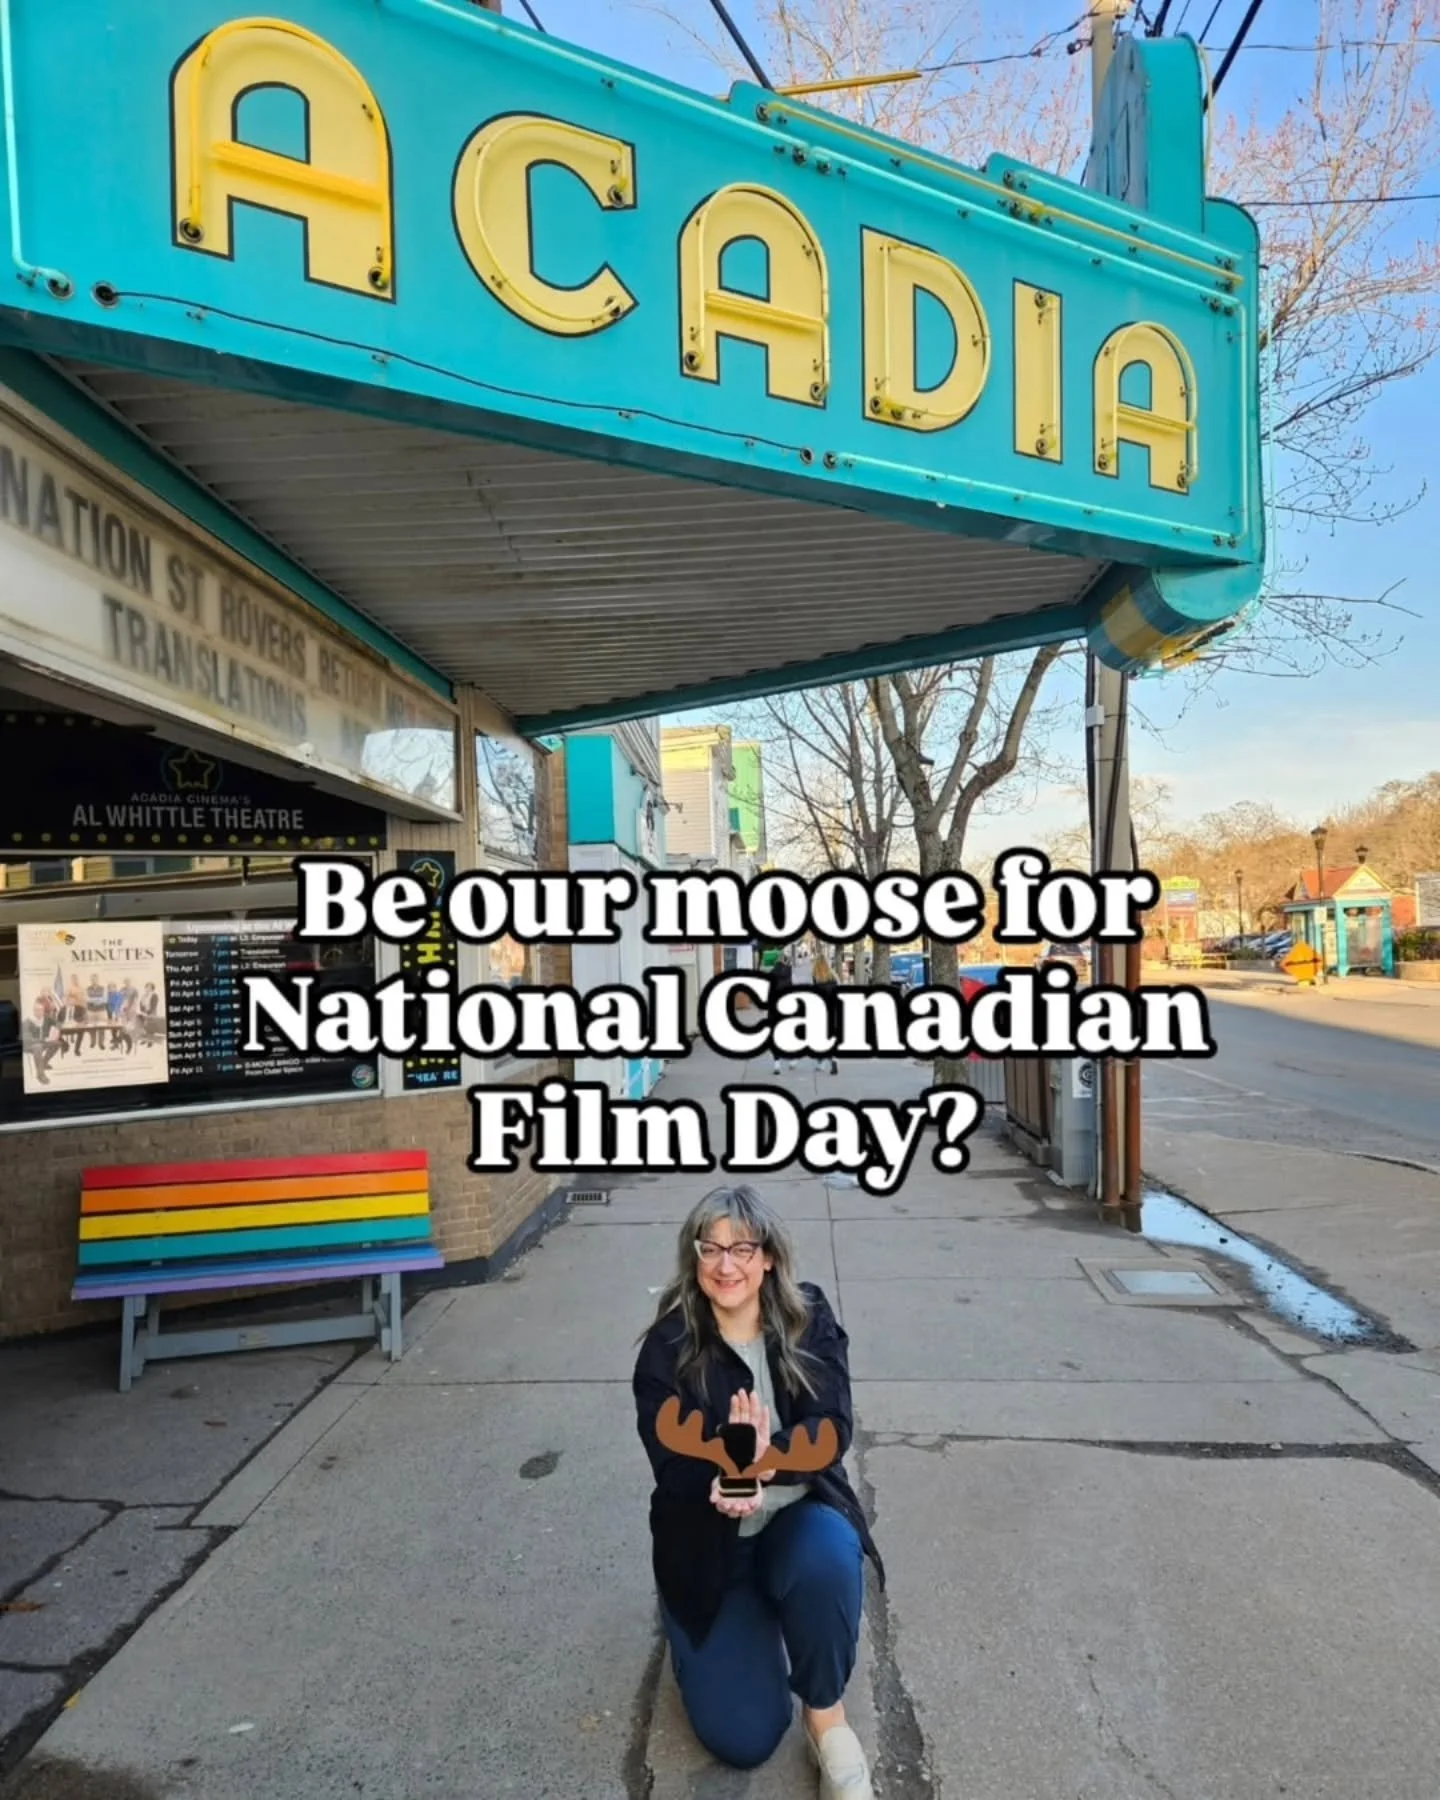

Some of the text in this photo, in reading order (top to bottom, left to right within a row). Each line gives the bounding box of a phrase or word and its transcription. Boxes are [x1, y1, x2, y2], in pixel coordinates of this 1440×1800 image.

[168, 16, 1199, 497] ACADIA
[2, 446, 153, 600] NATION
[167, 554, 205, 630] ST
[220, 585, 307, 681] ROVERS
[130, 792, 183, 804] ACADIA
[72, 804, 304, 831] AL WHITTLE THEATRE
[101, 938, 123, 946] THE
[177, 935, 199, 945] Today
[71, 947, 155, 962] MINUTES
